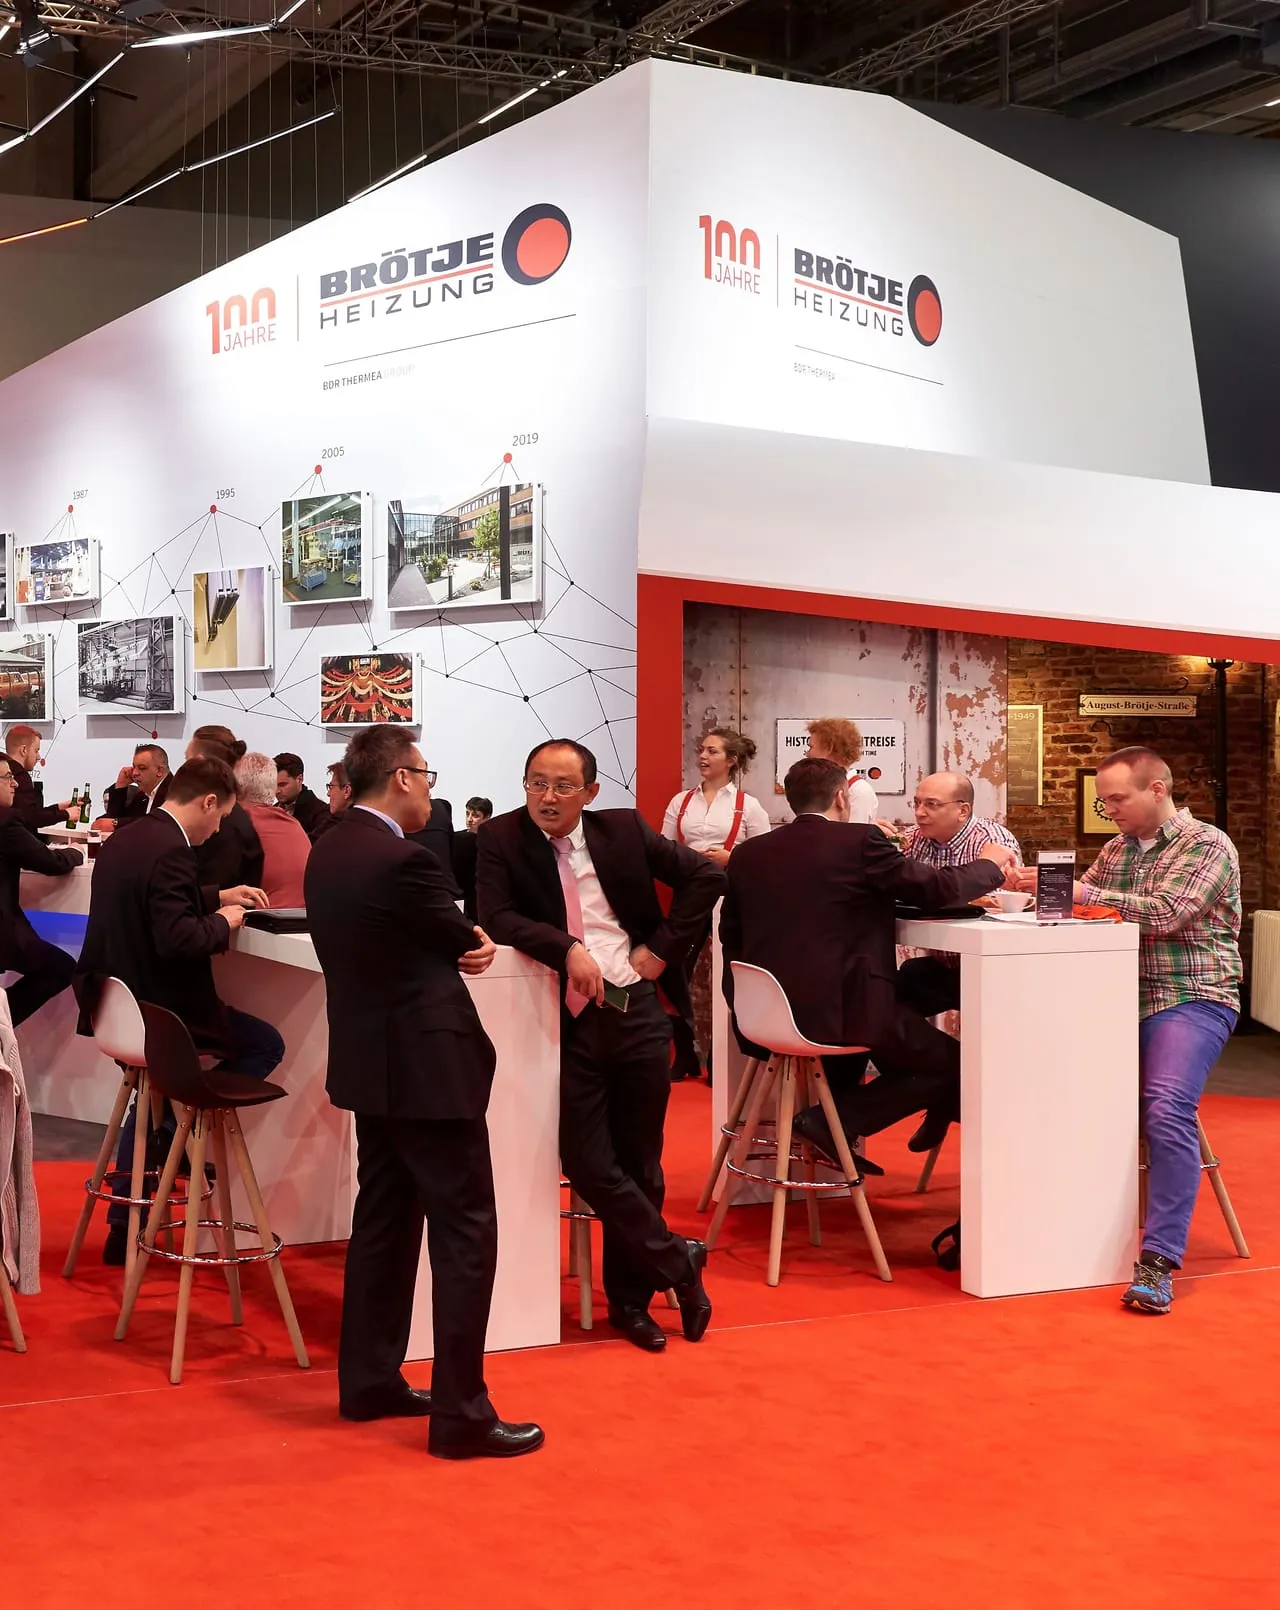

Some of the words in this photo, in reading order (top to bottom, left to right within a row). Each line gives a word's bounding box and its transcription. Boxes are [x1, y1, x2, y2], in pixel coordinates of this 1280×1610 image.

[698, 214, 761, 281] 100
[320, 231, 494, 300] BRÖTJE
[715, 263, 761, 295] JAHRE
[794, 247, 904, 308] BRÖTJE
[320, 272, 494, 330] HEIZUNG
[794, 287, 904, 337] HEIZUNG
[206, 286, 276, 355] 100
[223, 322, 277, 352] JAHRE
[323, 379, 340, 391] BDR
[341, 370, 383, 387] THERMEA
[321, 446, 345, 460] 2005
[512, 432, 539, 447] 2019
[72, 489, 89, 501] 1987
[216, 487, 236, 500] 1995
[1086, 701, 1190, 711] August-Brötje-Straße
